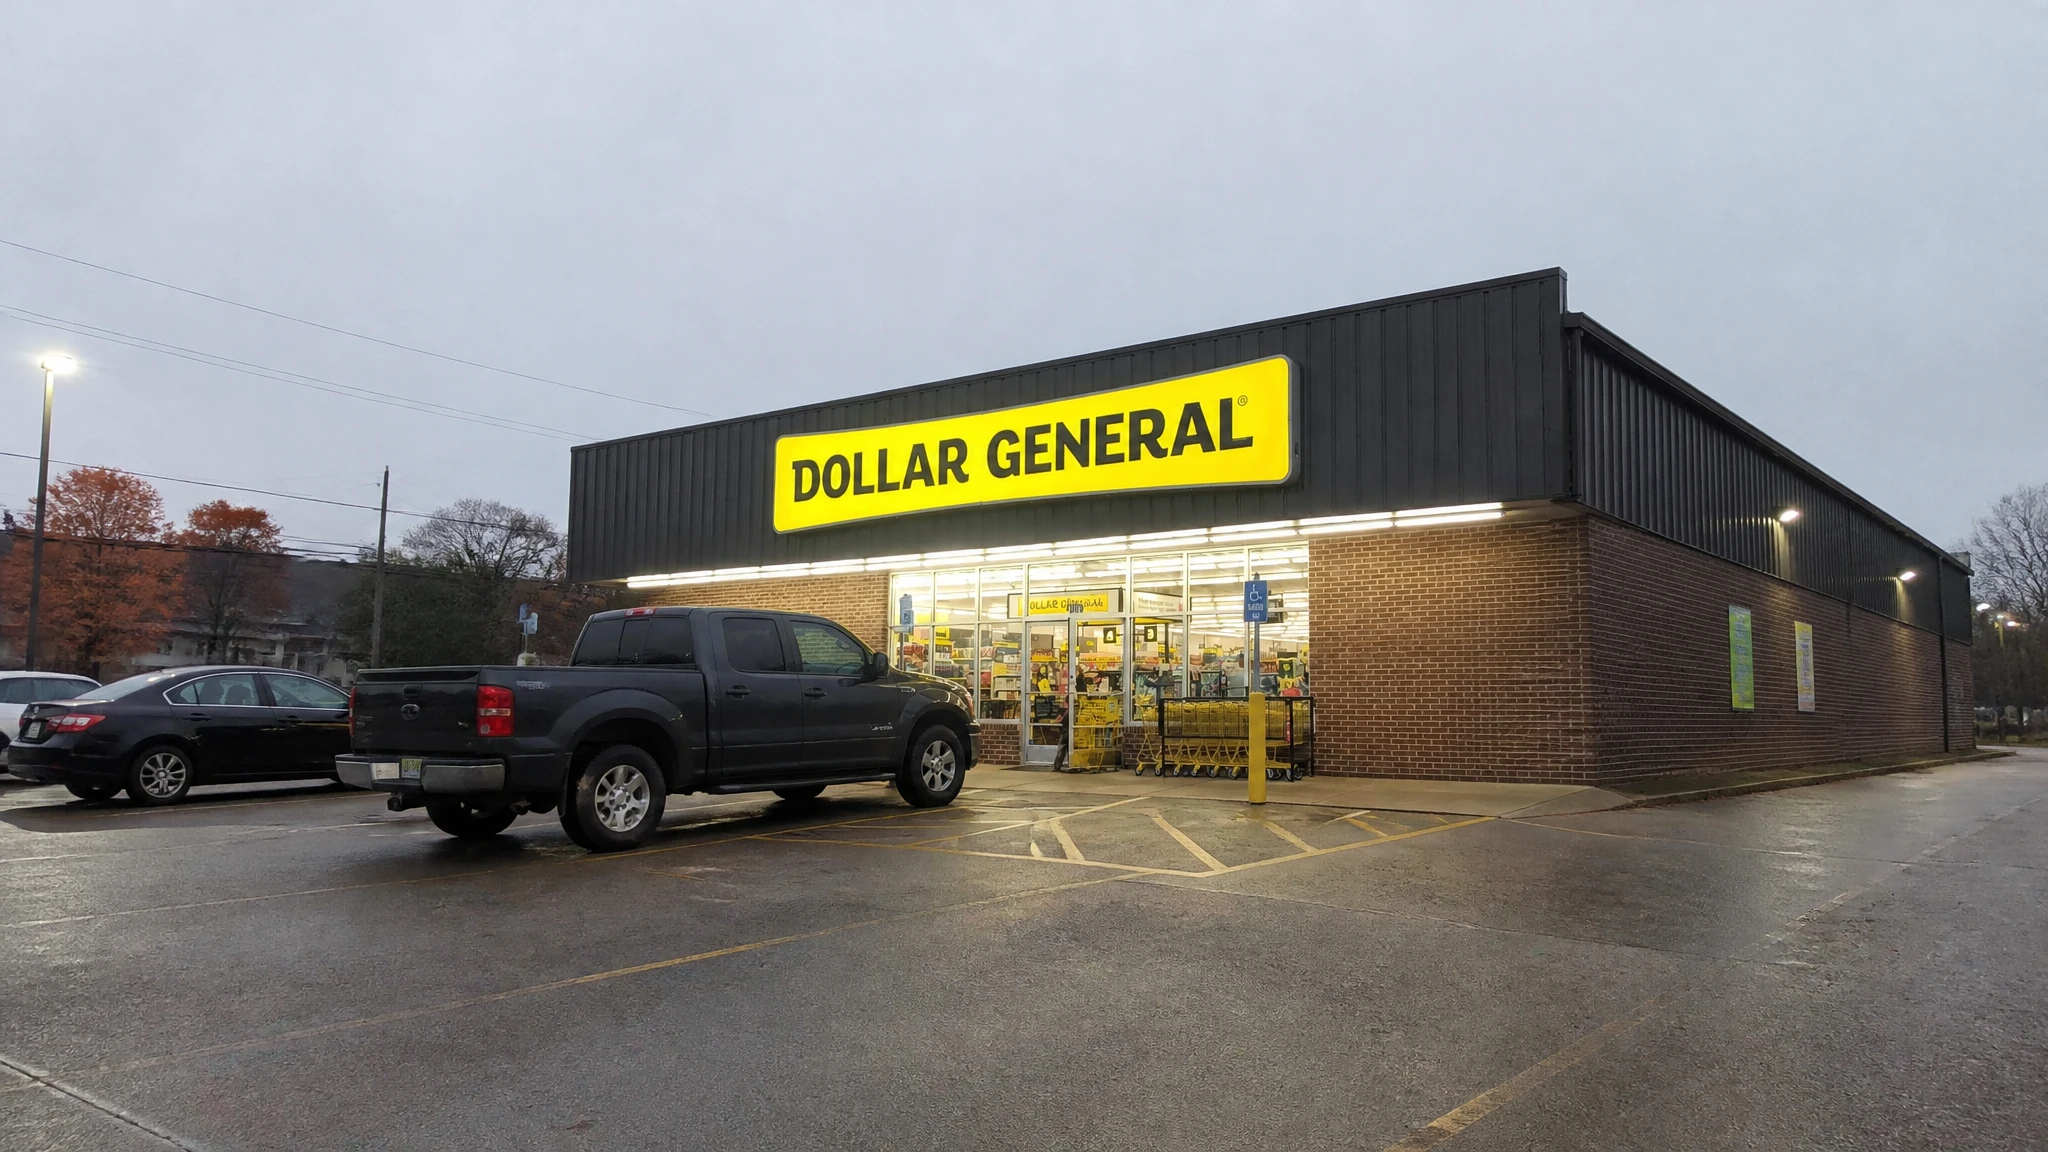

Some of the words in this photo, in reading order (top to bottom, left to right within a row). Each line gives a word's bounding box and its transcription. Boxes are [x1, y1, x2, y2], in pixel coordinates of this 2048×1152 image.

[792, 438, 969, 502] DOLLAR
[986, 397, 1254, 479] GENERAL
[1029, 599, 1059, 610] OLLAR
